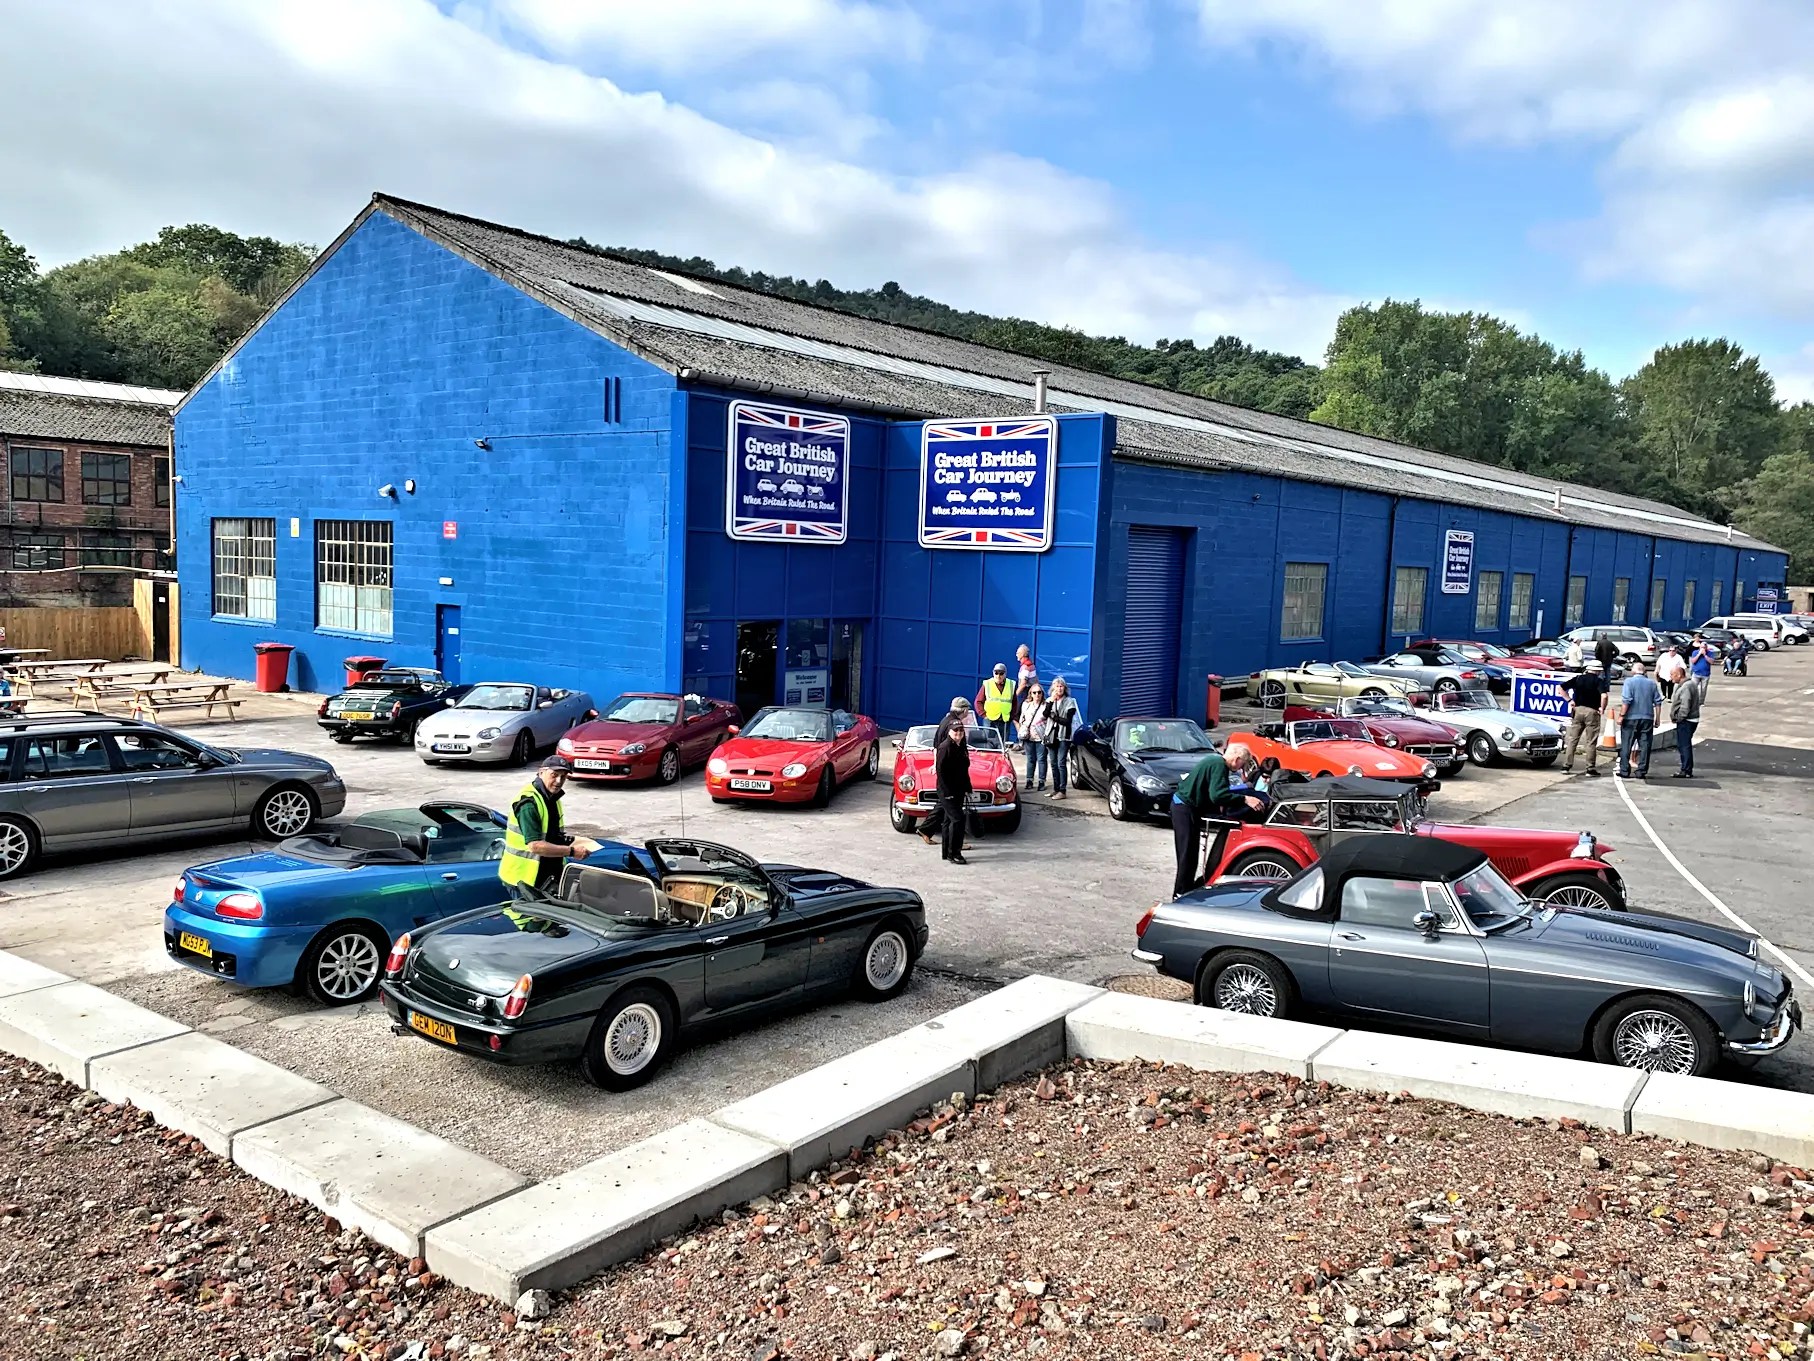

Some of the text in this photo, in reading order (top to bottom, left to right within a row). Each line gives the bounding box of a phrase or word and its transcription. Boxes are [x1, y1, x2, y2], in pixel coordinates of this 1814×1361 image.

[745, 437, 836, 462] Great British
[935, 450, 1036, 468] Great British
[745, 454, 835, 482] Car Journey
[934, 468, 1036, 487] Car Journey
[743, 495, 835, 510] When Britain Ruled The Road
[932, 506, 1035, 516] When Britain Ruled The Road
[1529, 697, 1564, 713] WAY
[734, 779, 750, 788] P58
